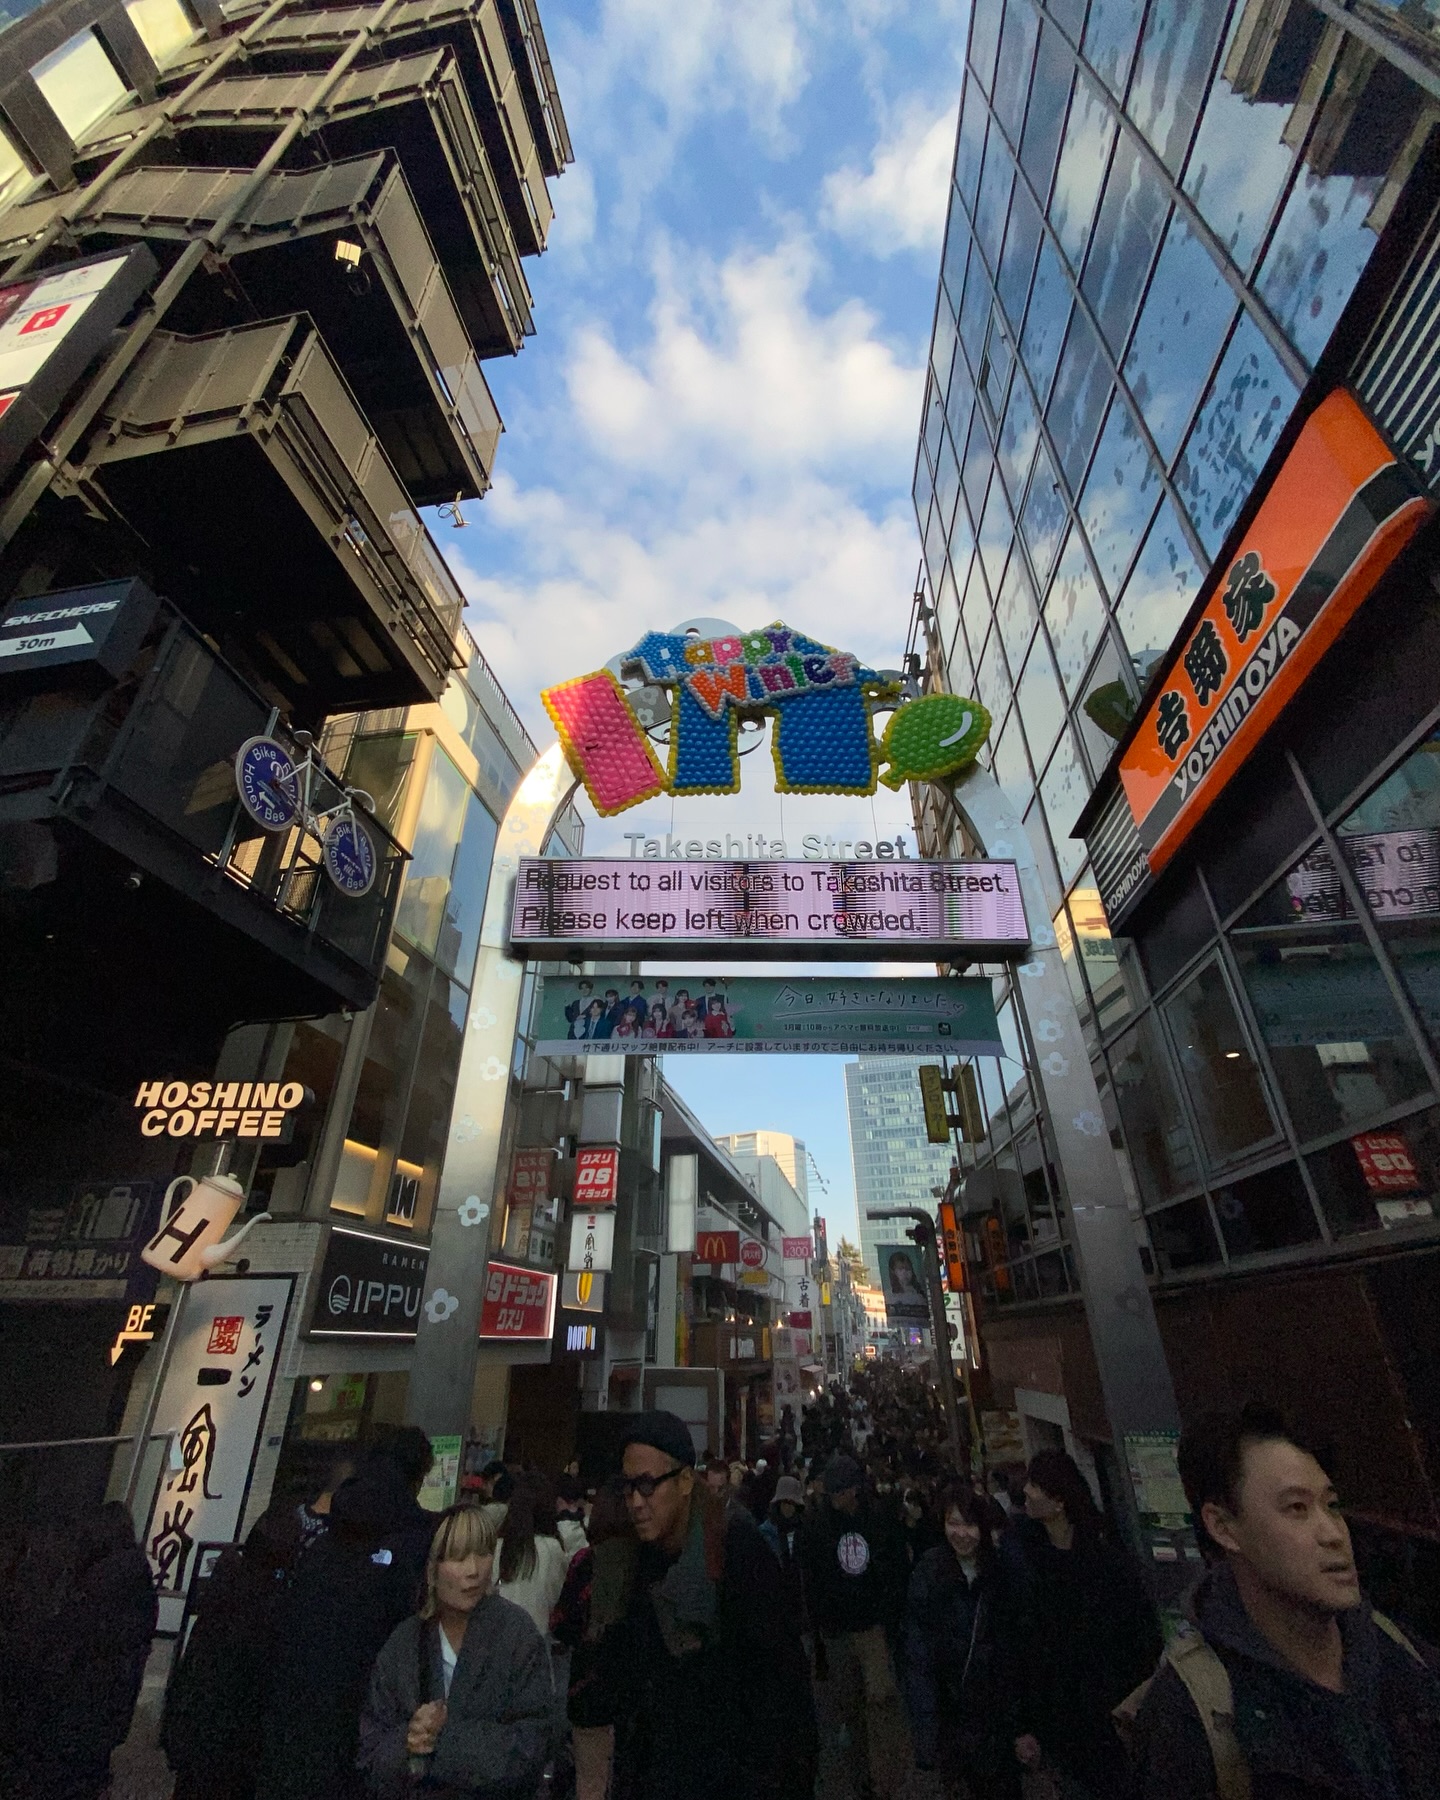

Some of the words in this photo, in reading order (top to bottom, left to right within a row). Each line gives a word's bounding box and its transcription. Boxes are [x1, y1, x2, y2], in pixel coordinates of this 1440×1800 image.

[2, 600, 120, 628] SKECHERS
[15, 637, 55, 651] 30m
[1157, 551, 1278, 763] 吉野家
[1174, 615, 1301, 801] YOSHINOYA
[252, 747, 277, 761] Bike
[244, 763, 263, 812] Honey
[264, 807, 286, 823] Bee
[624, 832, 787, 858] Takeshita
[802, 833, 909, 859] Street
[525, 868, 620, 892] Request
[628, 872, 651, 891] to
[658, 870, 682, 891] all
[690, 871, 774, 891] visitors
[783, 873, 804, 891] to
[811, 870, 923, 892] Takeshita
[930, 871, 1010, 893] Street.
[523, 907, 607, 930] Please
[616, 908, 676, 932] keep
[686, 908, 726, 930] left
[734, 909, 799, 930] when
[808, 909, 922, 931] crowded.
[134, 1081, 304, 1109] HOSHINO
[141, 1109, 285, 1137] COFFEE
[580, 1153, 611, 1165] クスリ
[578, 1168, 611, 1185] OS
[576, 1188, 610, 1199] ドラッグ
[382, 1253, 425, 1271] RAMEN
[485, 1270, 549, 1307] Sドラッグ
[797, 1277, 811, 1308] 古着
[127, 1304, 156, 1331] BF
[496, 1307, 525, 1331] クスリ
[237, 1304, 274, 1399] ラーメン
